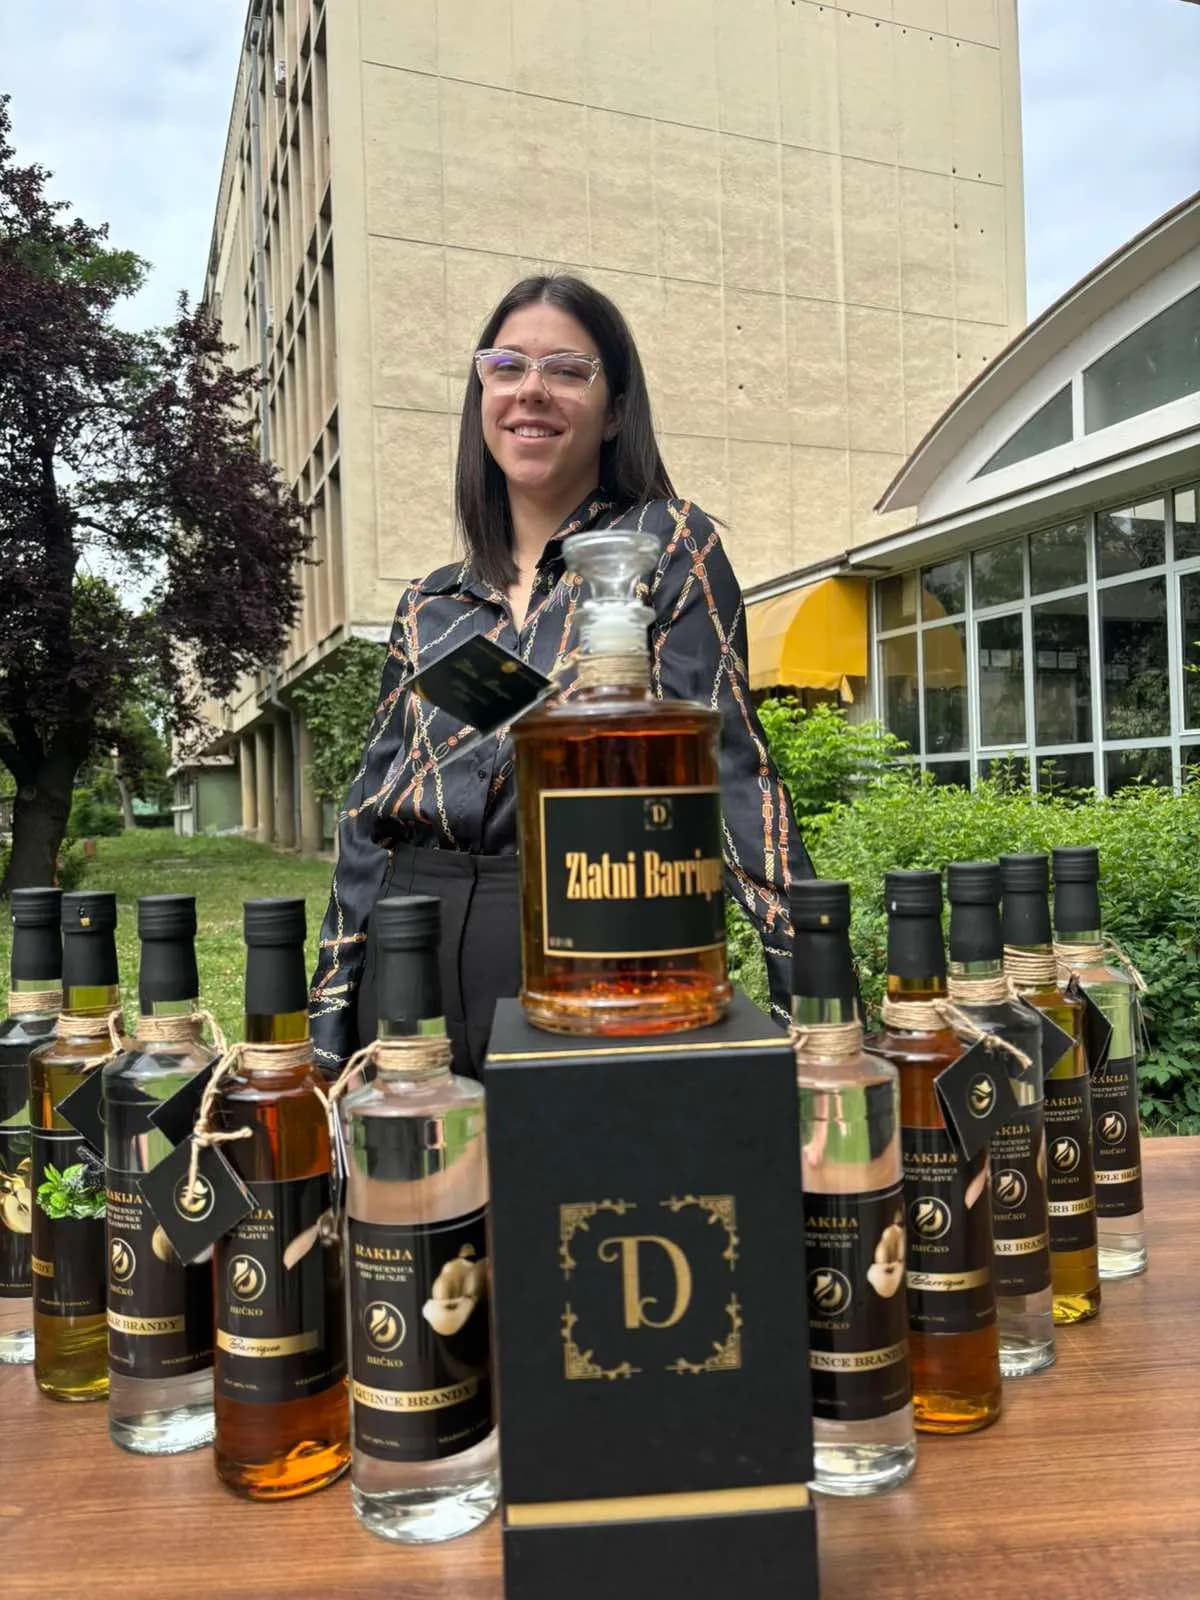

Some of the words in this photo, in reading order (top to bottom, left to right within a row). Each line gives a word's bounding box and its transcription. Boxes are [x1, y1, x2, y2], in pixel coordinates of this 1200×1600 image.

[652, 804, 665, 823] D
[565, 852, 636, 899] Zlatni
[807, 1217, 858, 1228] AKIJA
[355, 1243, 413, 1260] RAKIJA
[598, 1235, 691, 1329] D
[122, 1319, 177, 1332] BRANDY
[229, 1337, 281, 1356] Barrique
[354, 1386, 403, 1407] QUINCE
[407, 1384, 471, 1407] BRANDY
